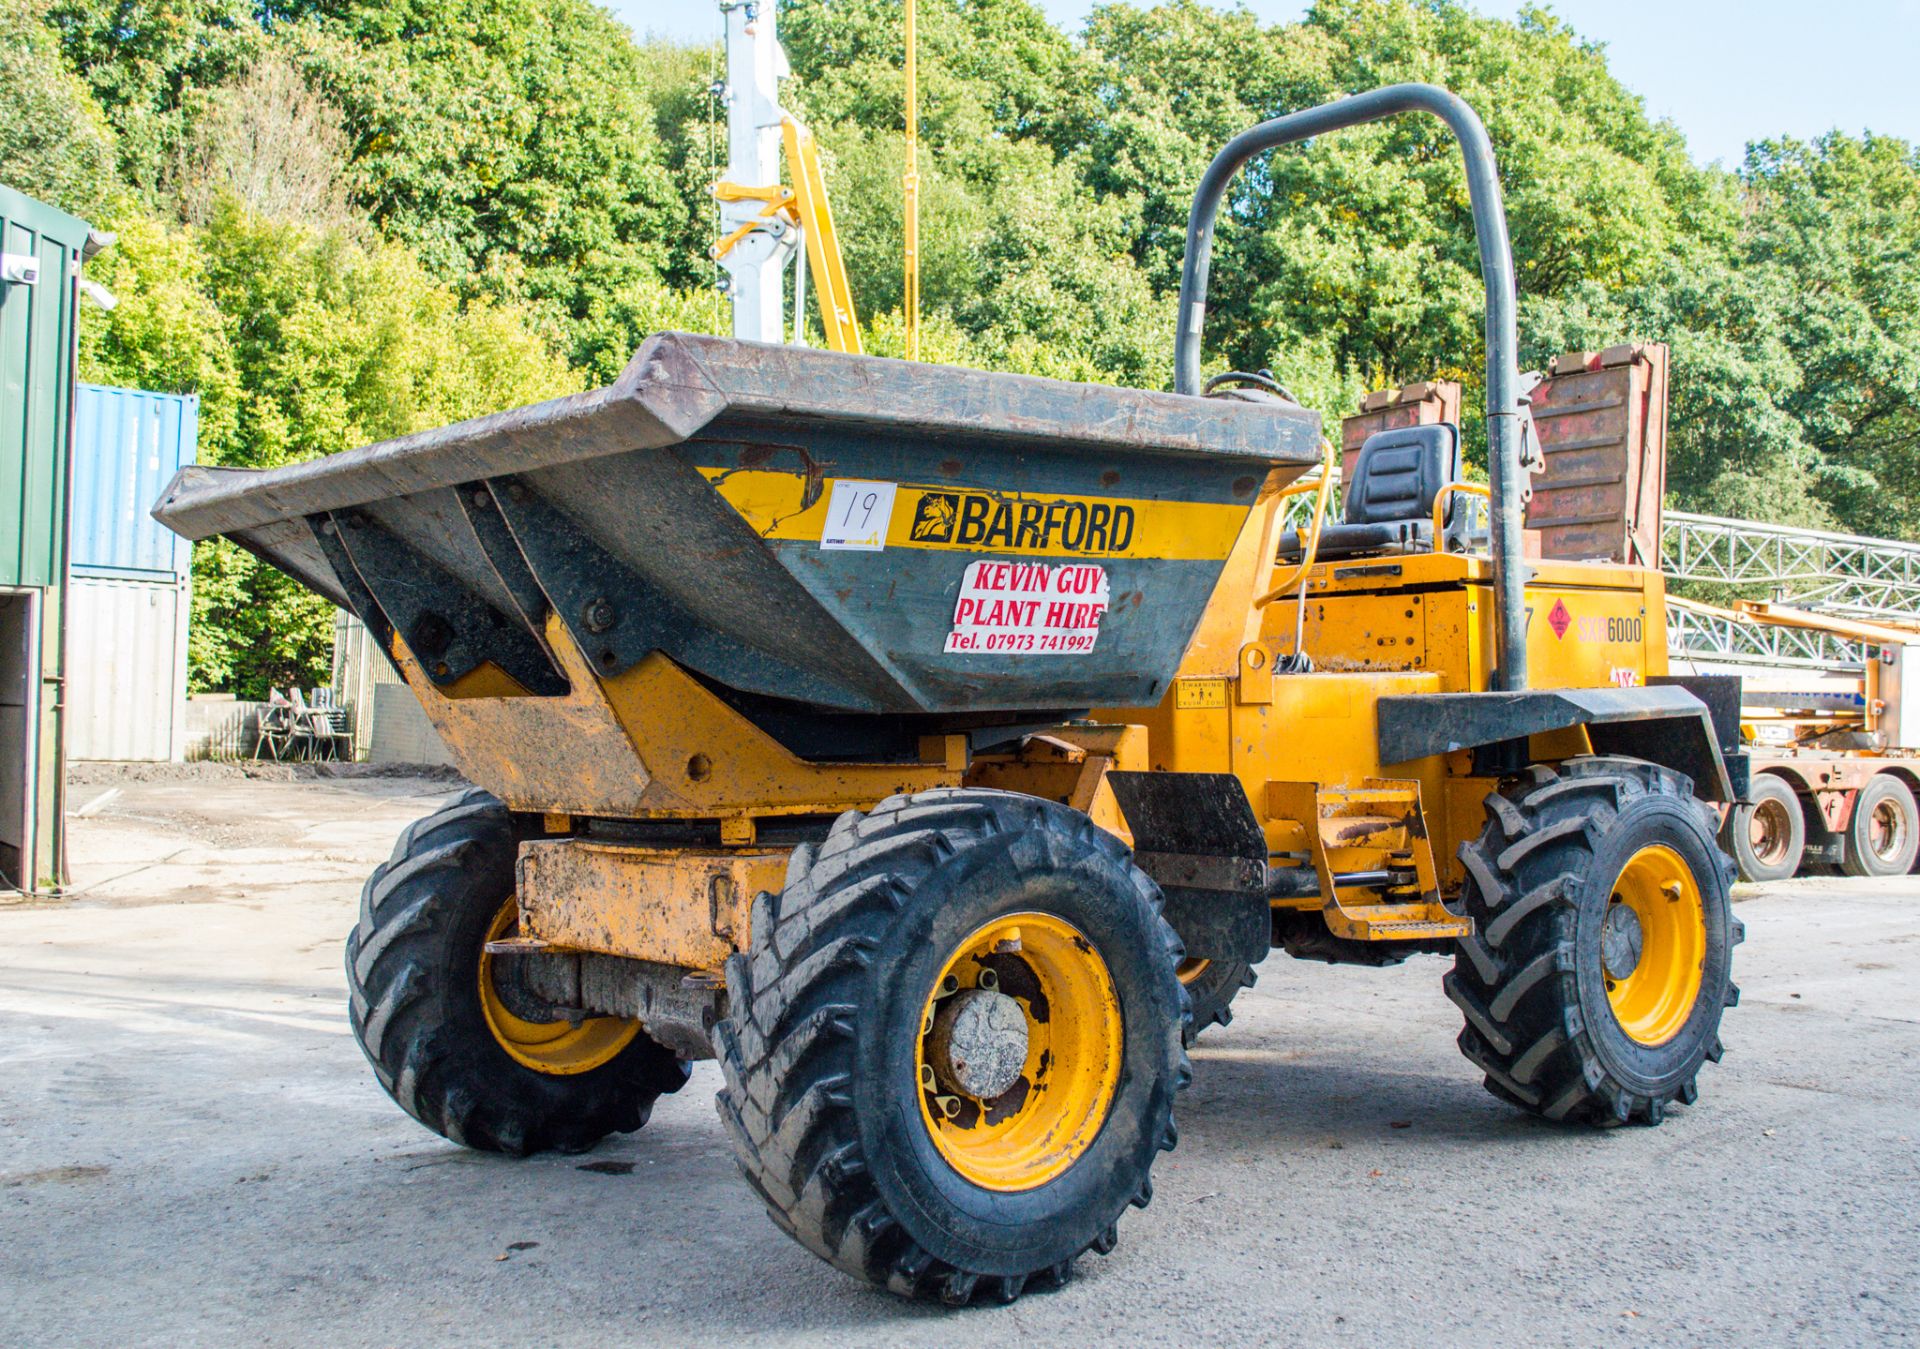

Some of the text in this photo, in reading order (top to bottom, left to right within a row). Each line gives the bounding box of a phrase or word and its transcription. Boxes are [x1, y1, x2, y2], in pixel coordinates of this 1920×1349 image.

[843, 491, 877, 529] 19
[956, 496, 1134, 551] BARFORD
[973, 563, 1104, 594] KEVIN GUY
[955, 598, 1104, 629] PLANT HIRE
[951, 633, 1093, 650] Tel. 07973 741992
